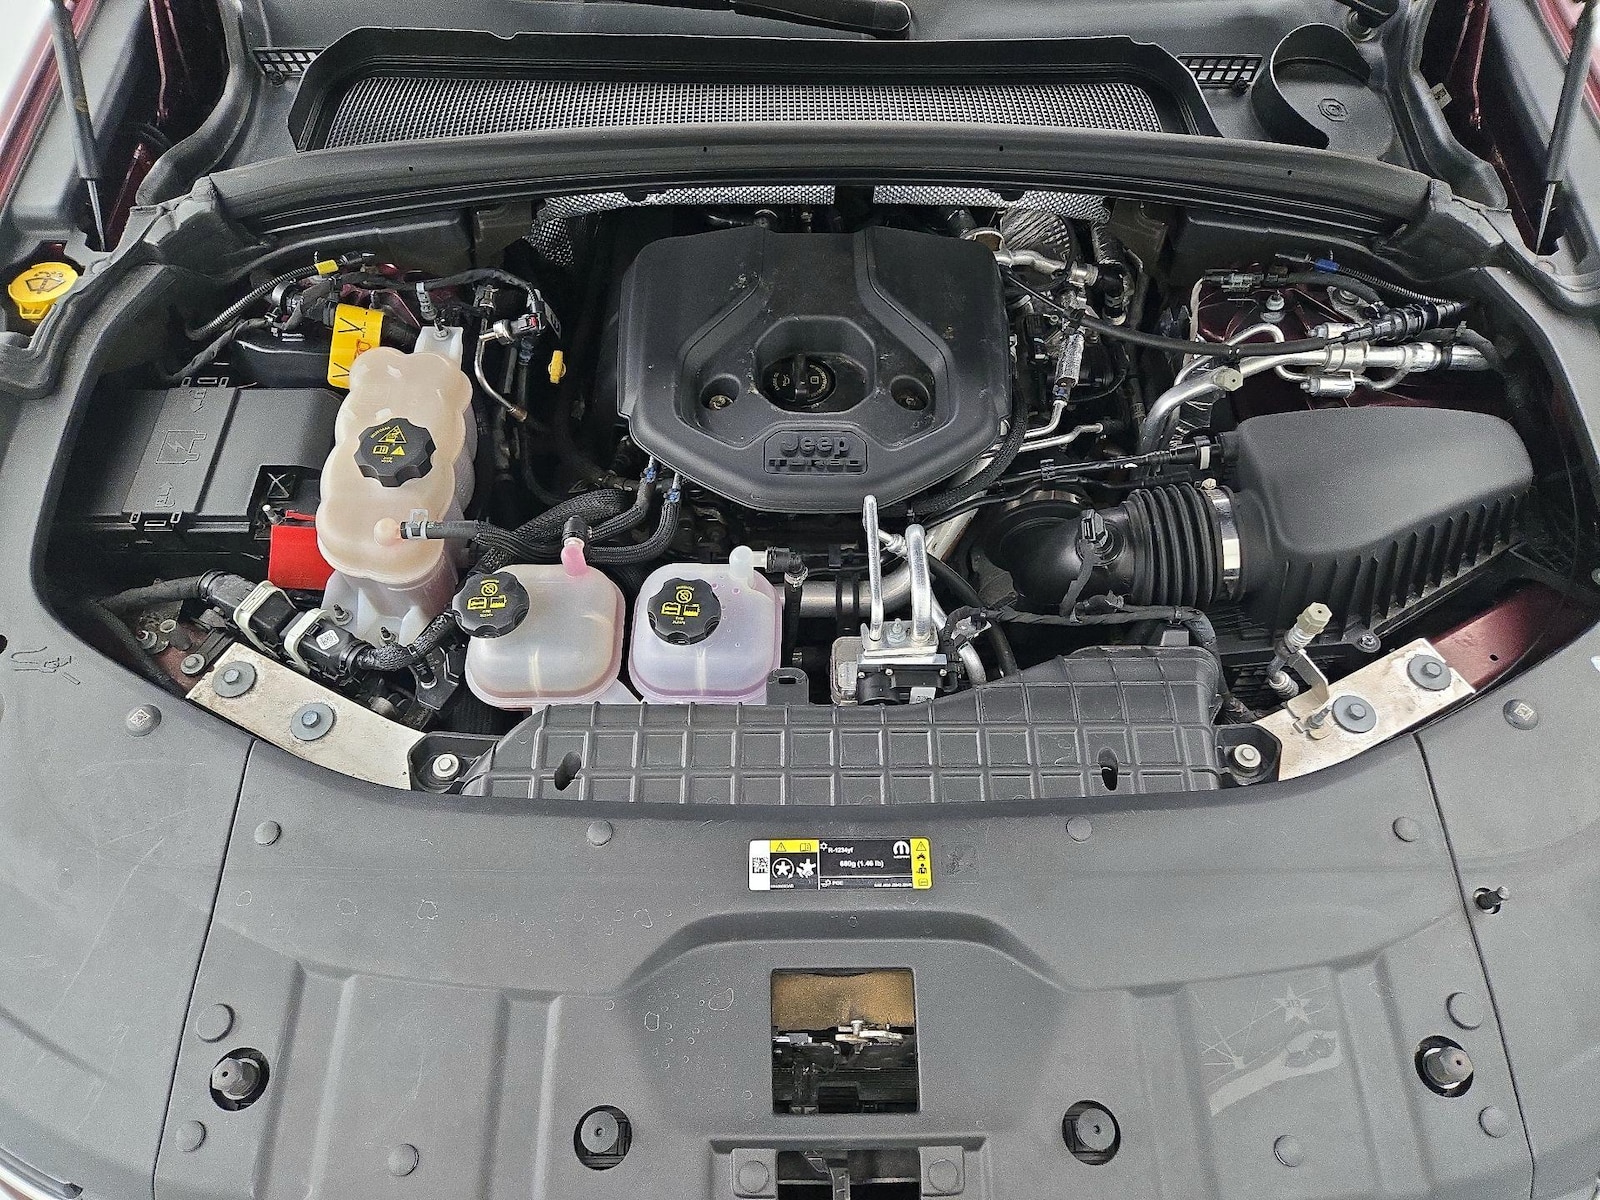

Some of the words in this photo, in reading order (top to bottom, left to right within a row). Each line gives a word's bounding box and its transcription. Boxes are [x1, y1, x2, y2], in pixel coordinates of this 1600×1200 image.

[780, 436, 851, 458] Jeep
[828, 846, 854, 854] R-1234yf
[874, 860, 884, 868] lb)
